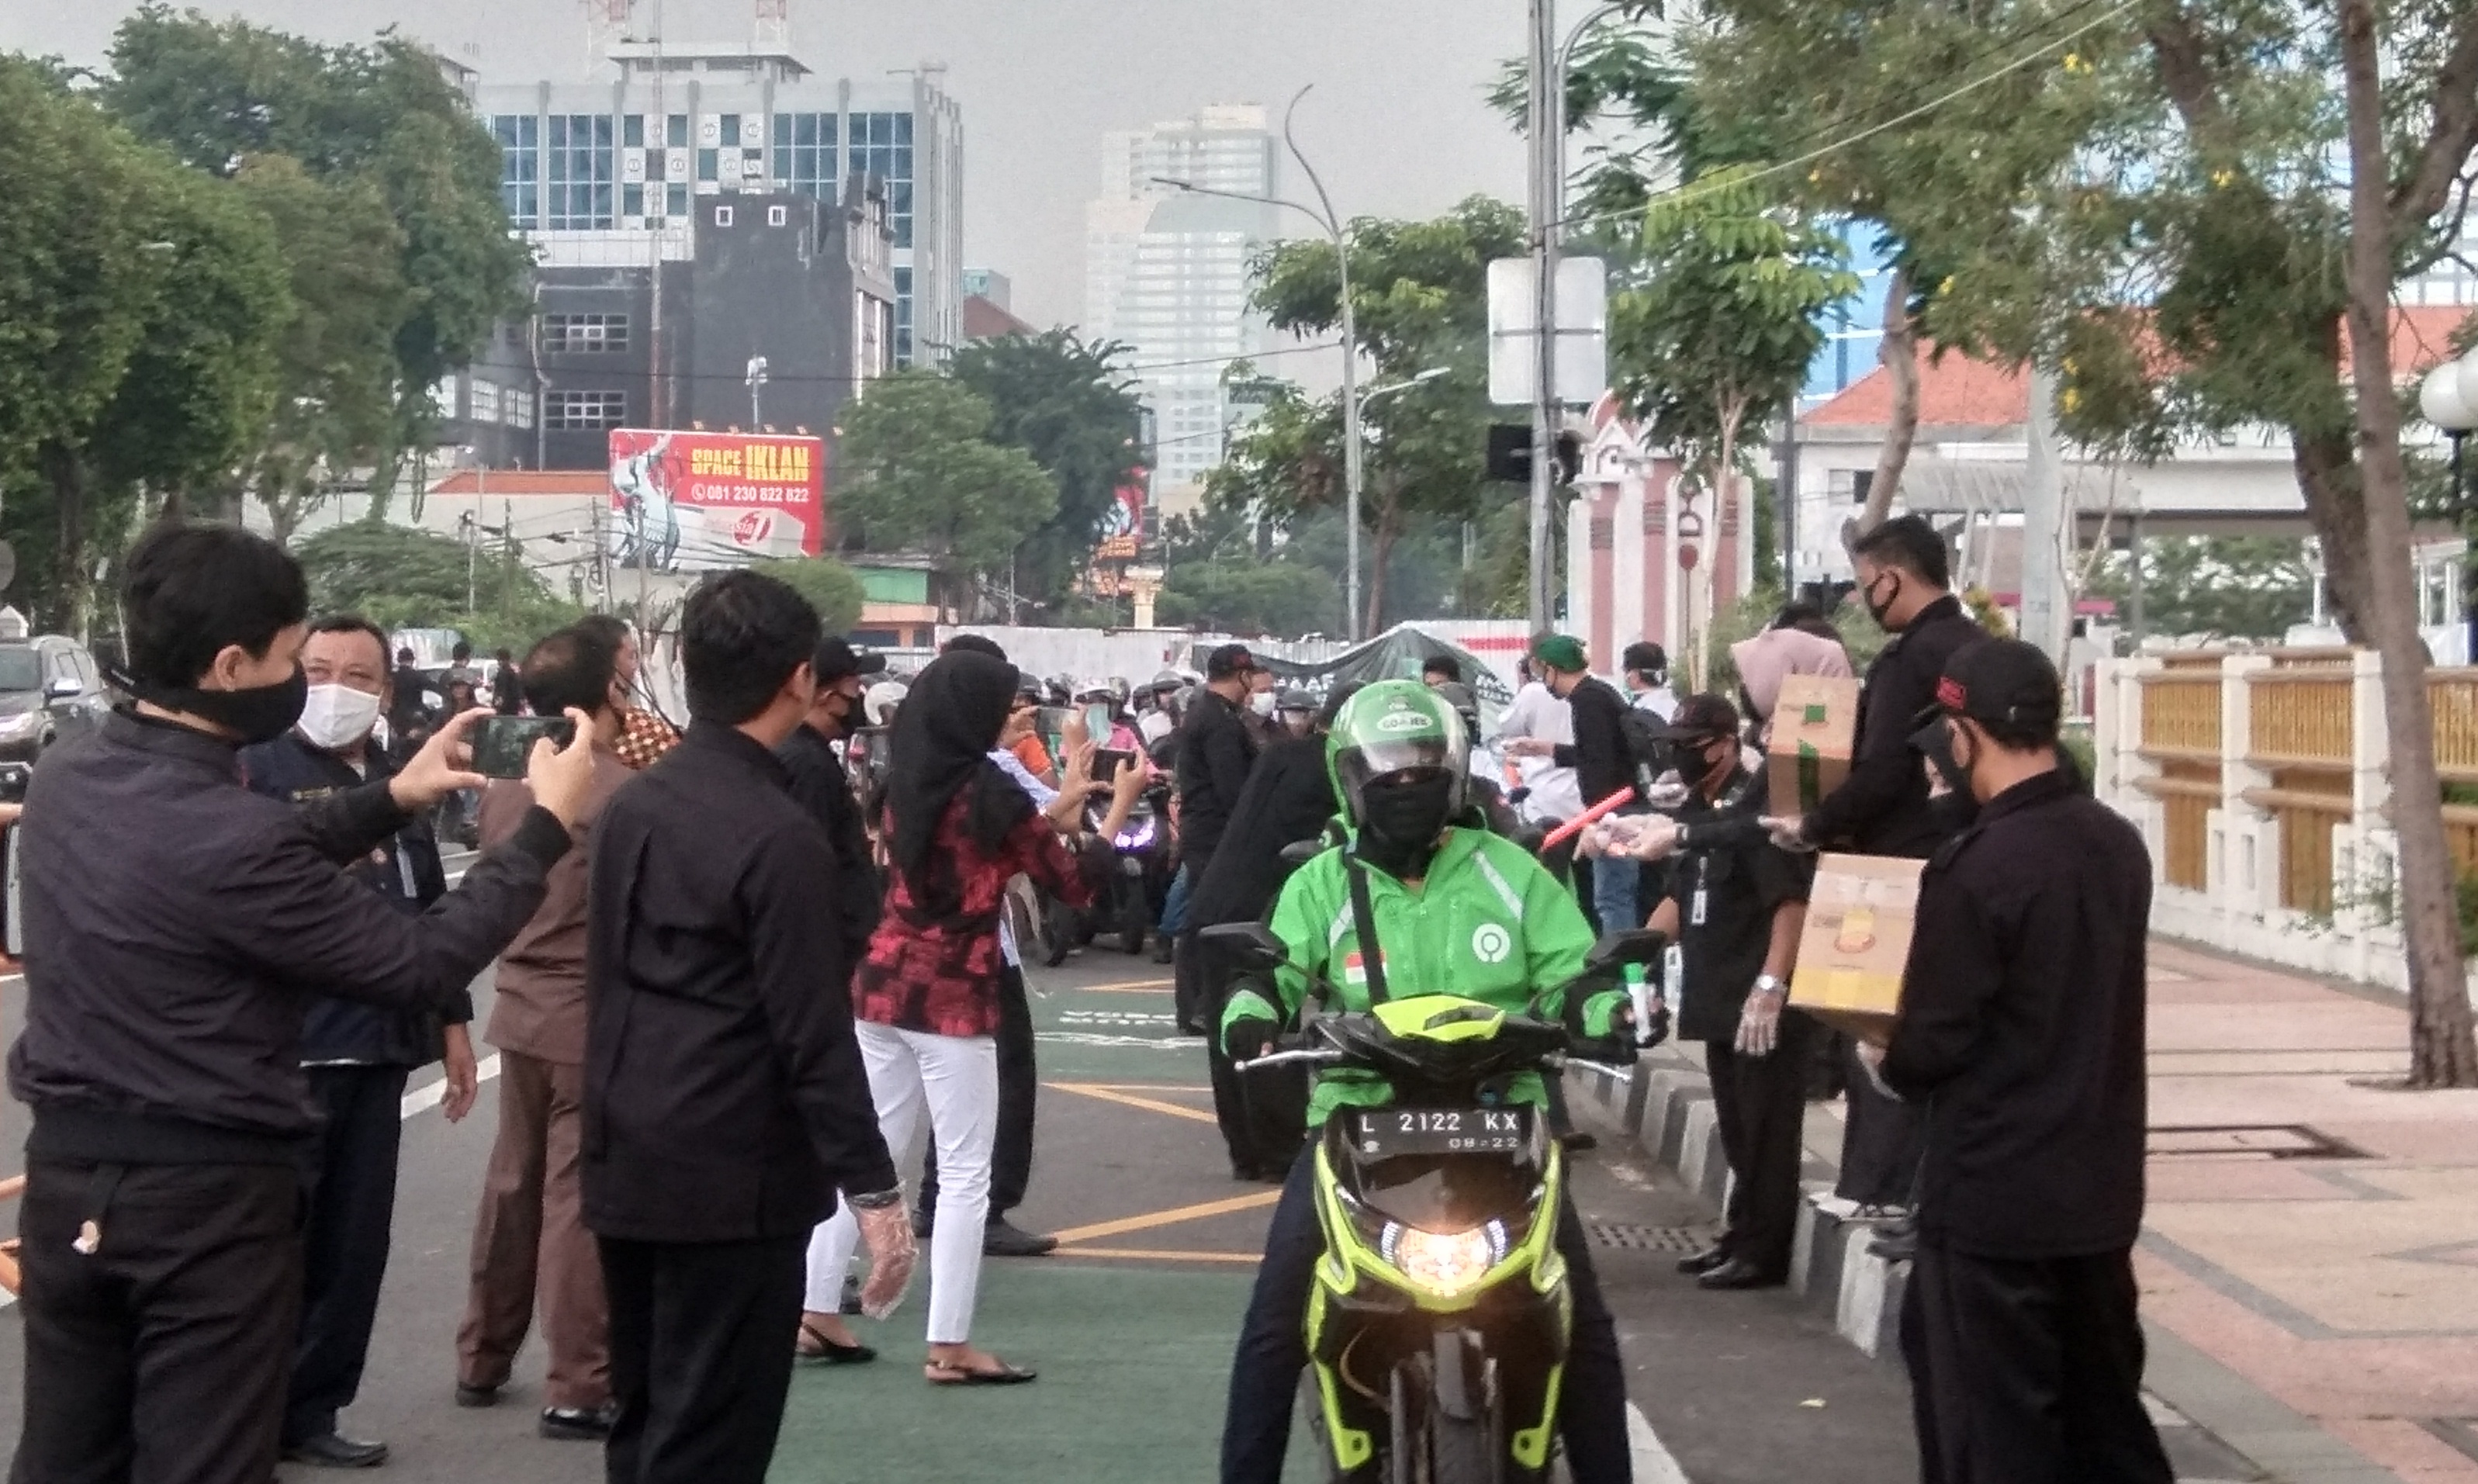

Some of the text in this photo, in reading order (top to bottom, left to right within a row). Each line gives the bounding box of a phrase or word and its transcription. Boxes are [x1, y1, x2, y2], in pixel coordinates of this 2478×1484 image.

[691, 445, 809, 481] SPACE IKLAN
[733, 486, 757, 501] 230
[760, 486, 784, 502] 822
[786, 487, 809, 503] 822
[1361, 1113, 1518, 1132] L 2122 KX
